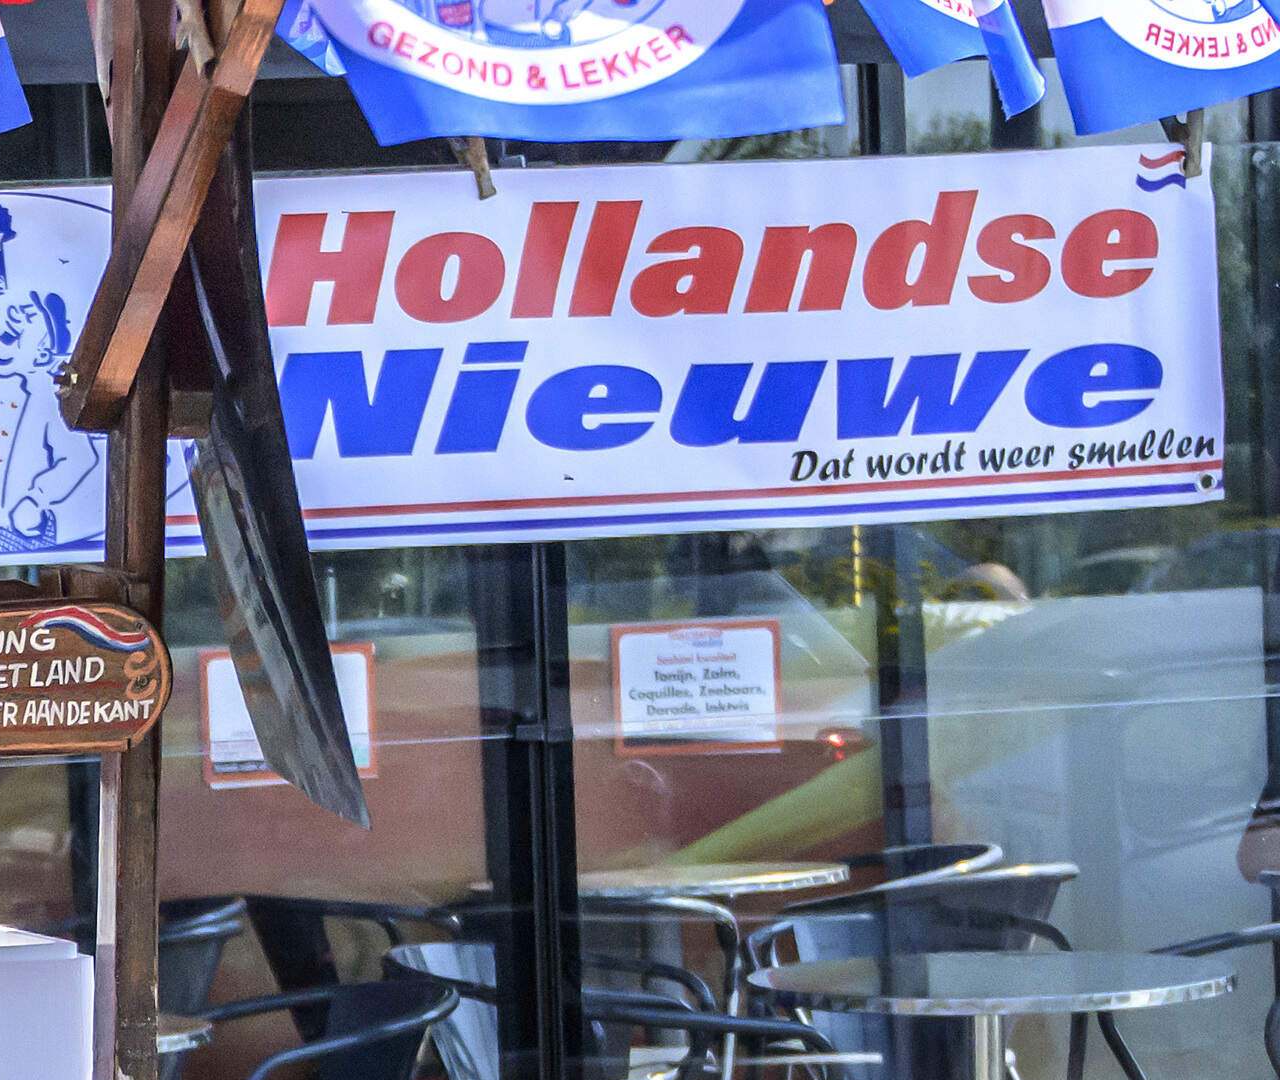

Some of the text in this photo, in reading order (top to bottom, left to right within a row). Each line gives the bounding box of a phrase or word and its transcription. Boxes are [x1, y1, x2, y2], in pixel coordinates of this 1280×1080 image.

[367, 22, 694, 91] GEZOND & LEKKER
[265, 189, 1159, 328] Hollandse
[277, 341, 1165, 460] Nieuwe
[789, 428, 1216, 482] Dat wordt weer smullen
